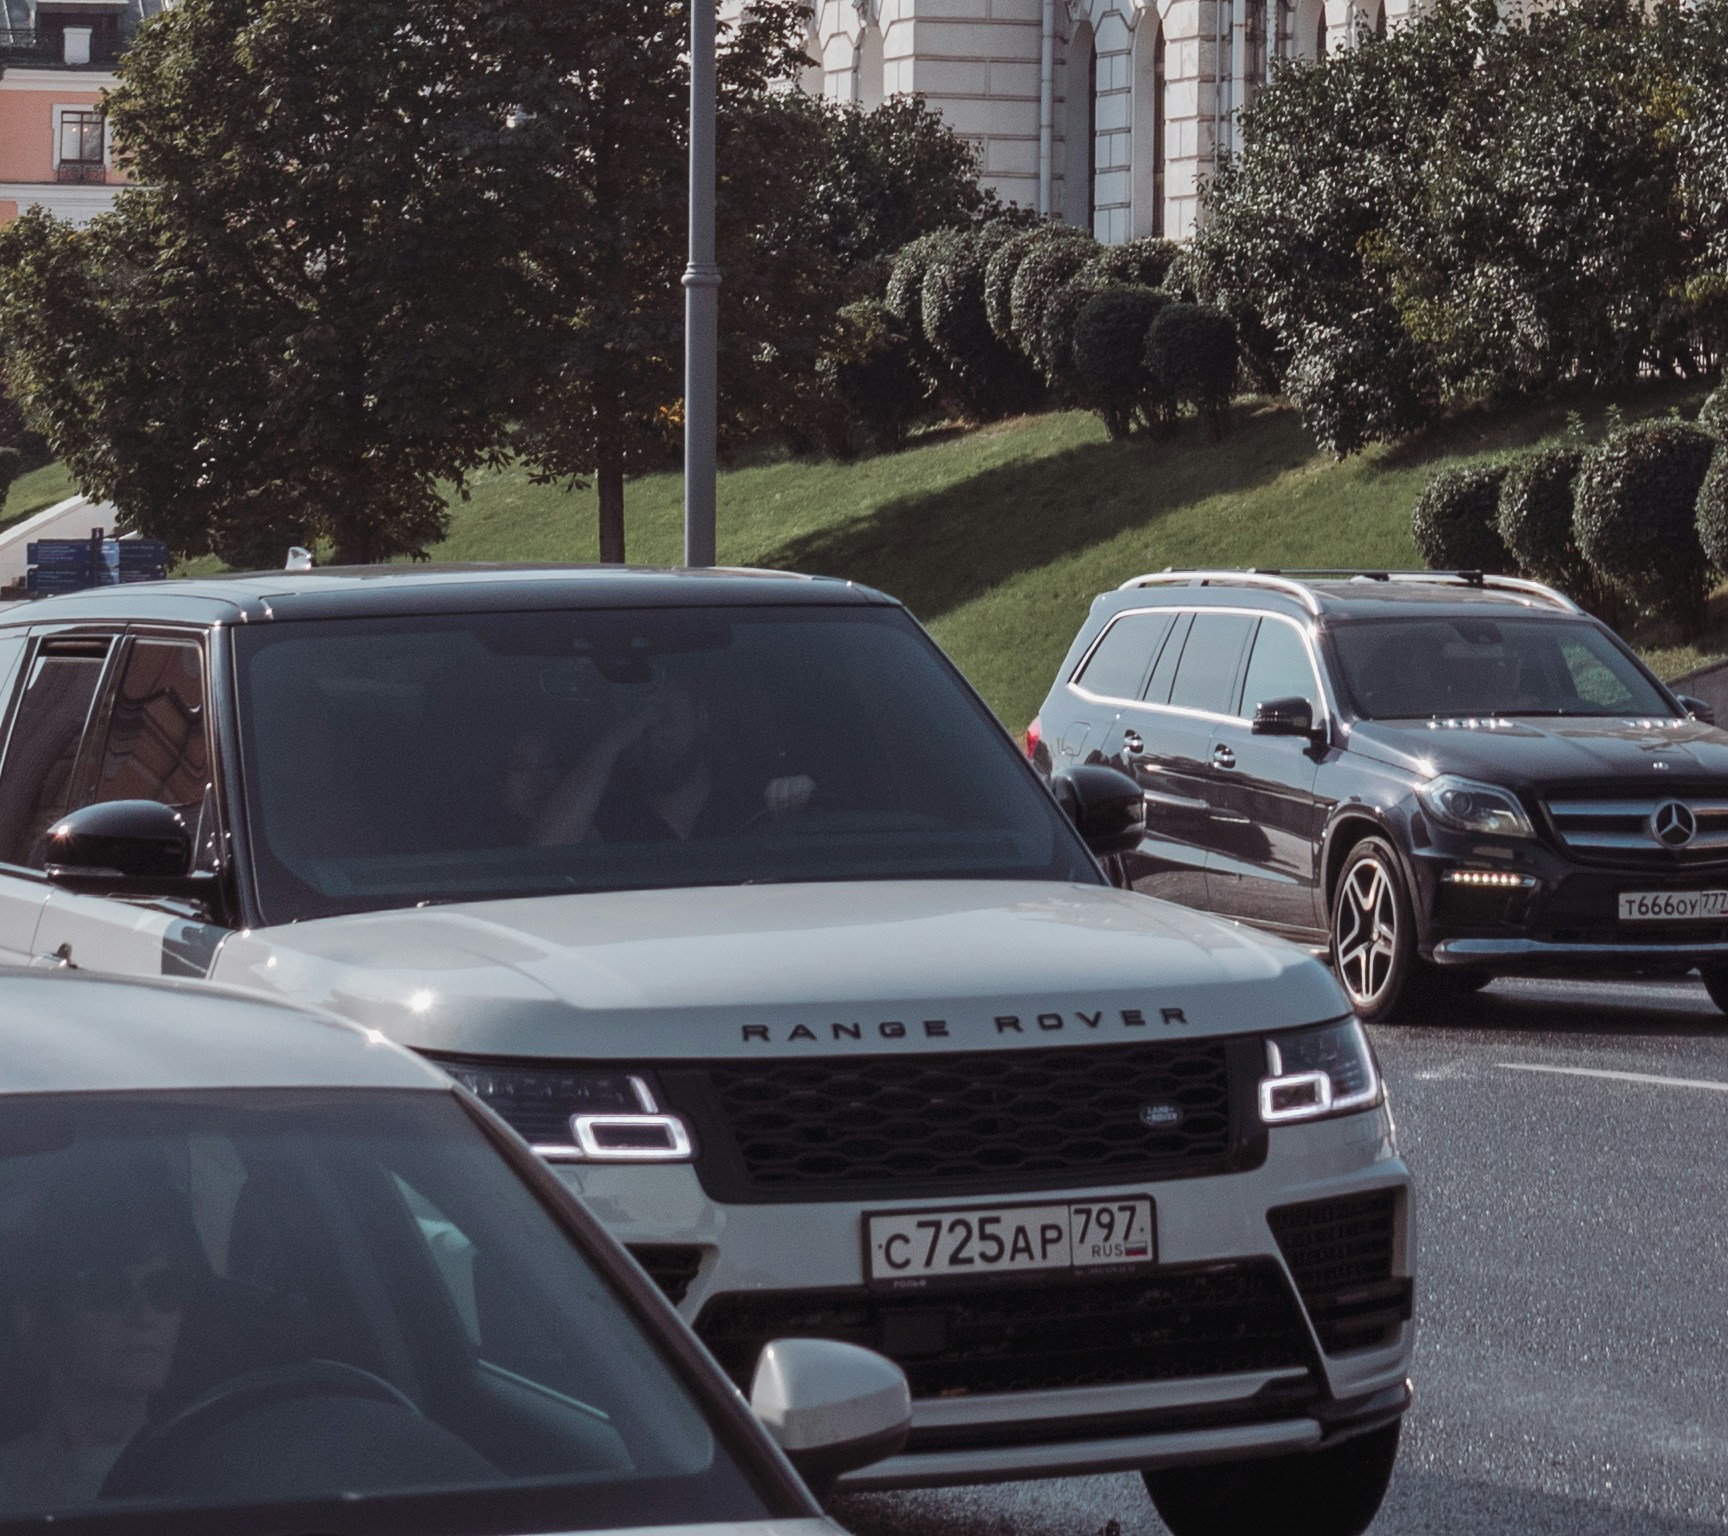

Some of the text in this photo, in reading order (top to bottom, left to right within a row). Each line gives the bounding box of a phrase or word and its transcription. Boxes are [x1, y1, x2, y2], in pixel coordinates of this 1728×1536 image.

[1702, 893, 1728, 909] 777
[741, 1006, 1188, 1043] RANGE ROVER
[1073, 1204, 1137, 1245] 797
[1091, 1242, 1123, 1259] RUS
